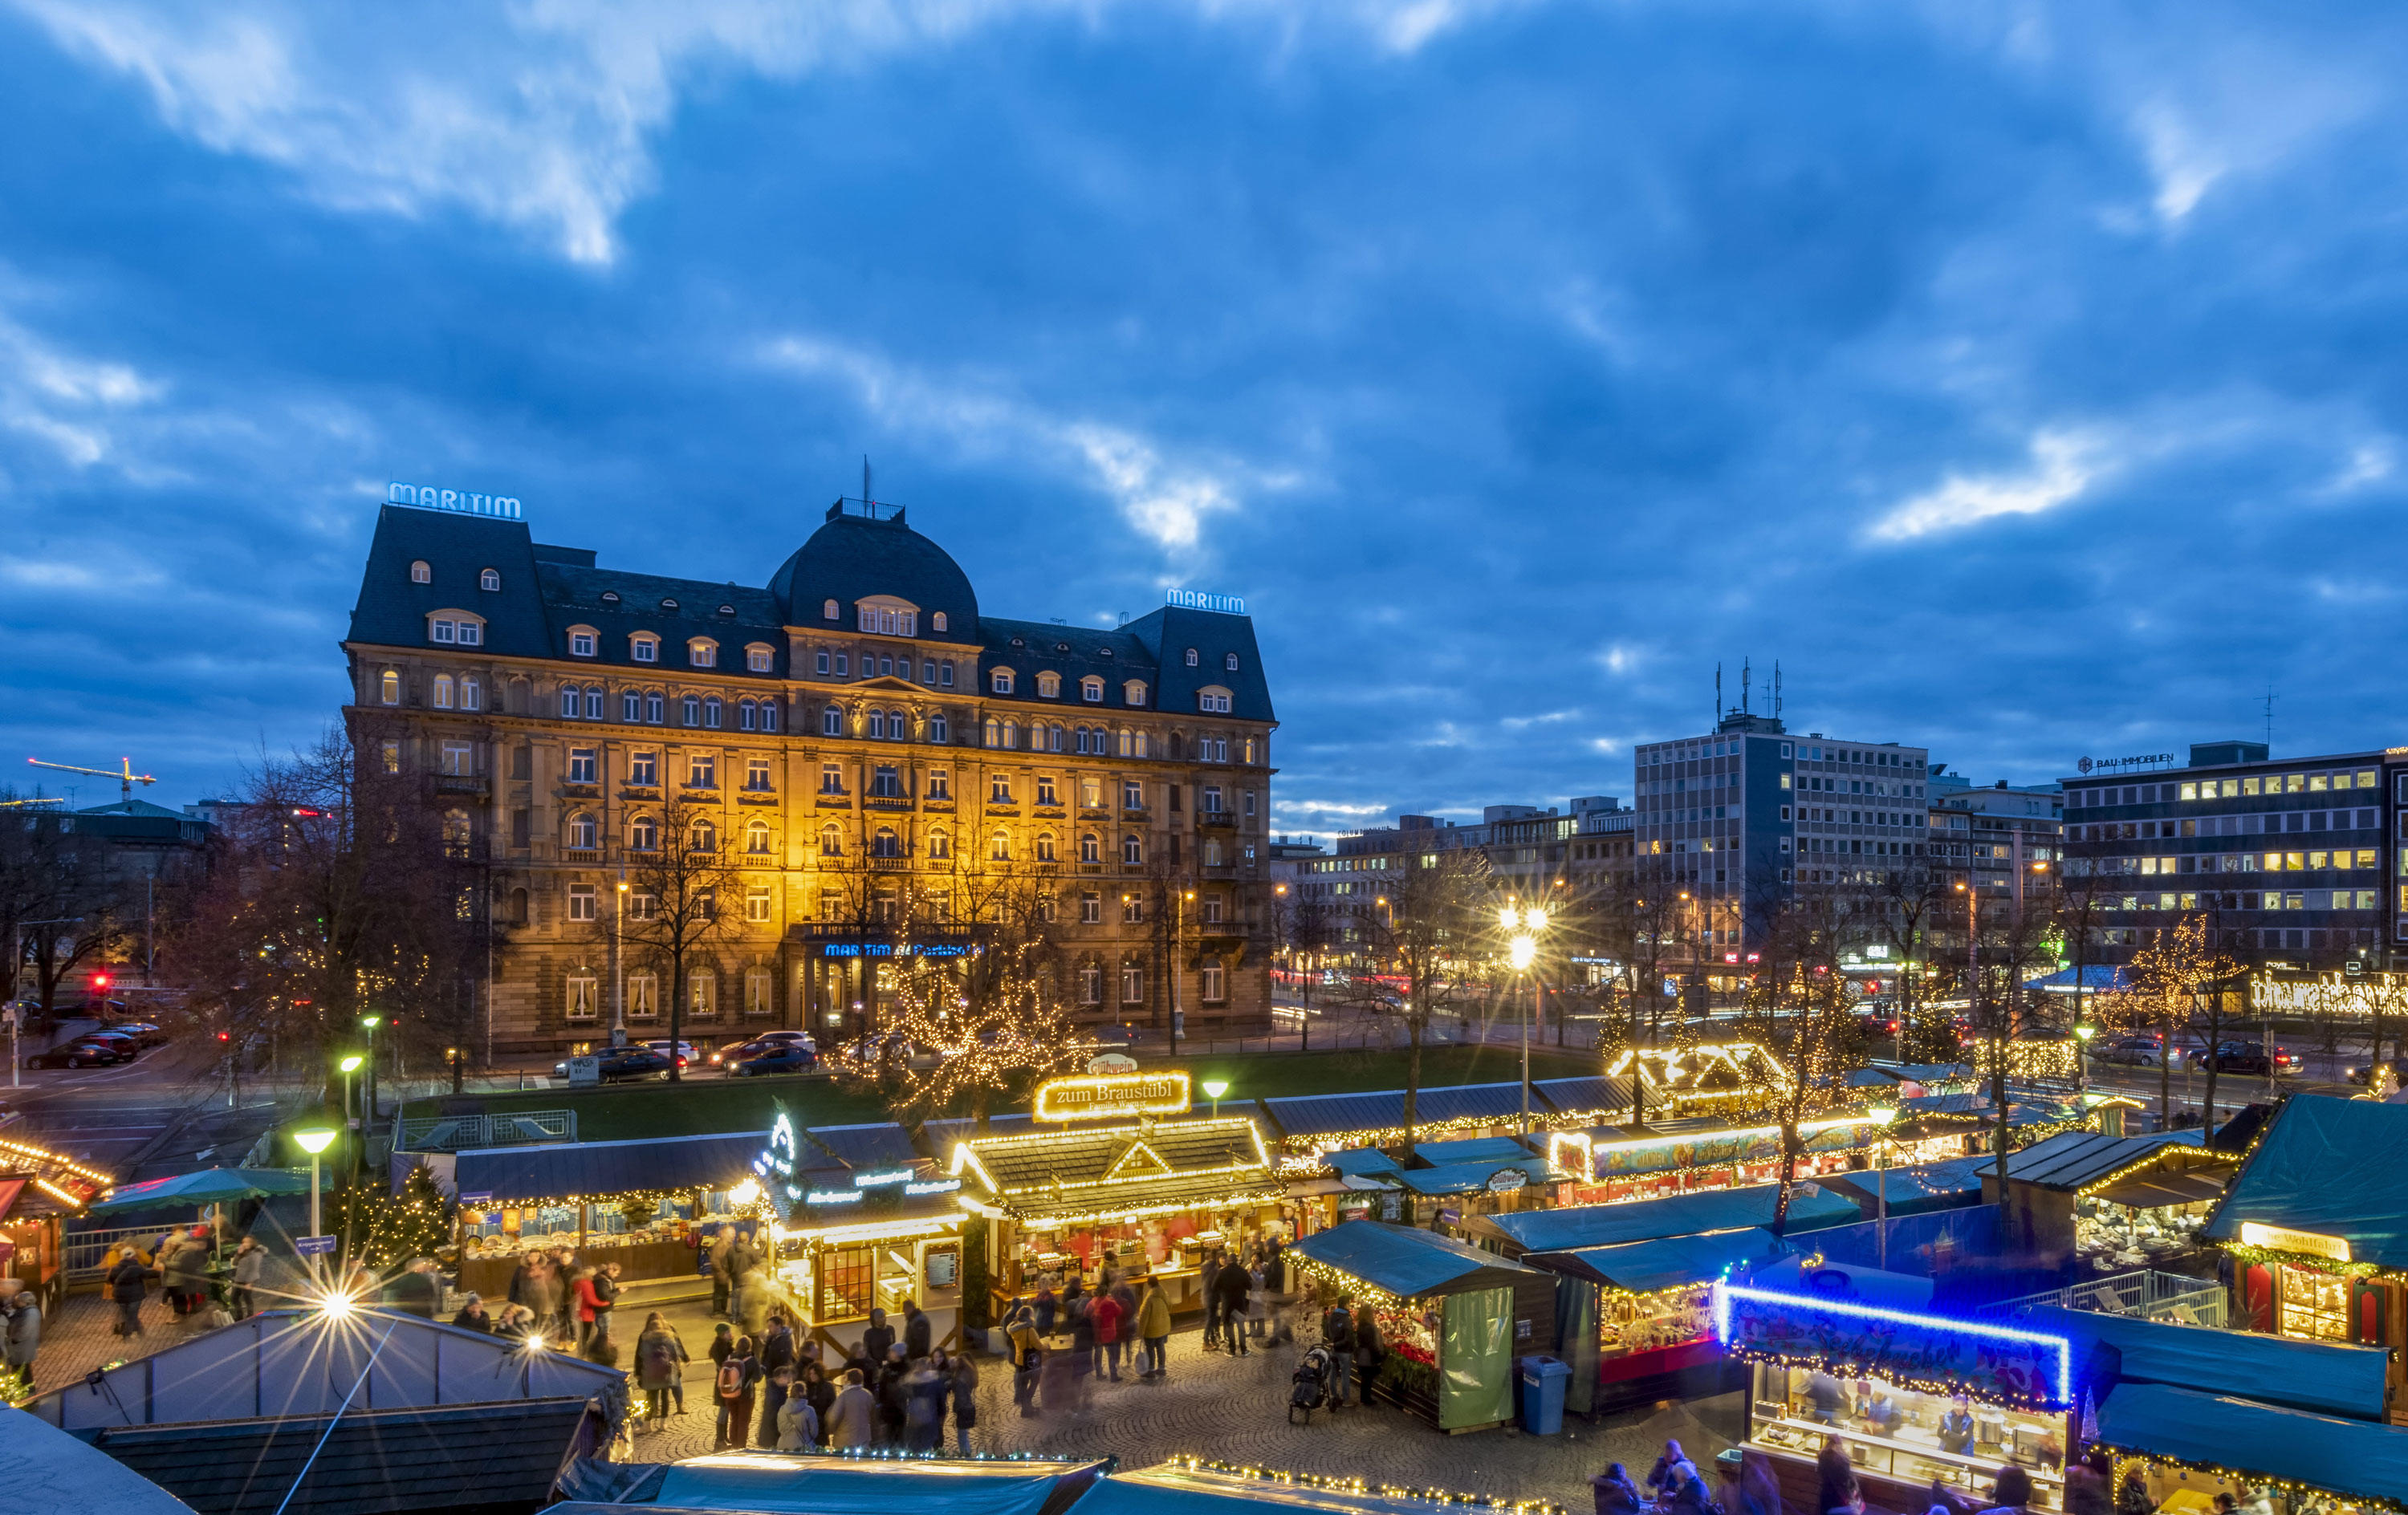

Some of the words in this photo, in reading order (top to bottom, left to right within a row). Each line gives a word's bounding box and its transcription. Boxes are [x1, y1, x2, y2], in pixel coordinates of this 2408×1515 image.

[388, 481, 521, 520] MARITIM
[1166, 587, 1244, 614] MARITIM
[825, 944, 891, 957] MARTIM
[1090, 1062, 1133, 1074] Glühwein
[1056, 1091, 1092, 1103] zum
[1096, 1082, 1172, 1102] Braustübl
[1088, 1101, 1117, 1111] Familie
[1119, 1099, 1148, 1110] Wagner
[2284, 1233, 2343, 1252] Wohlfahrt
